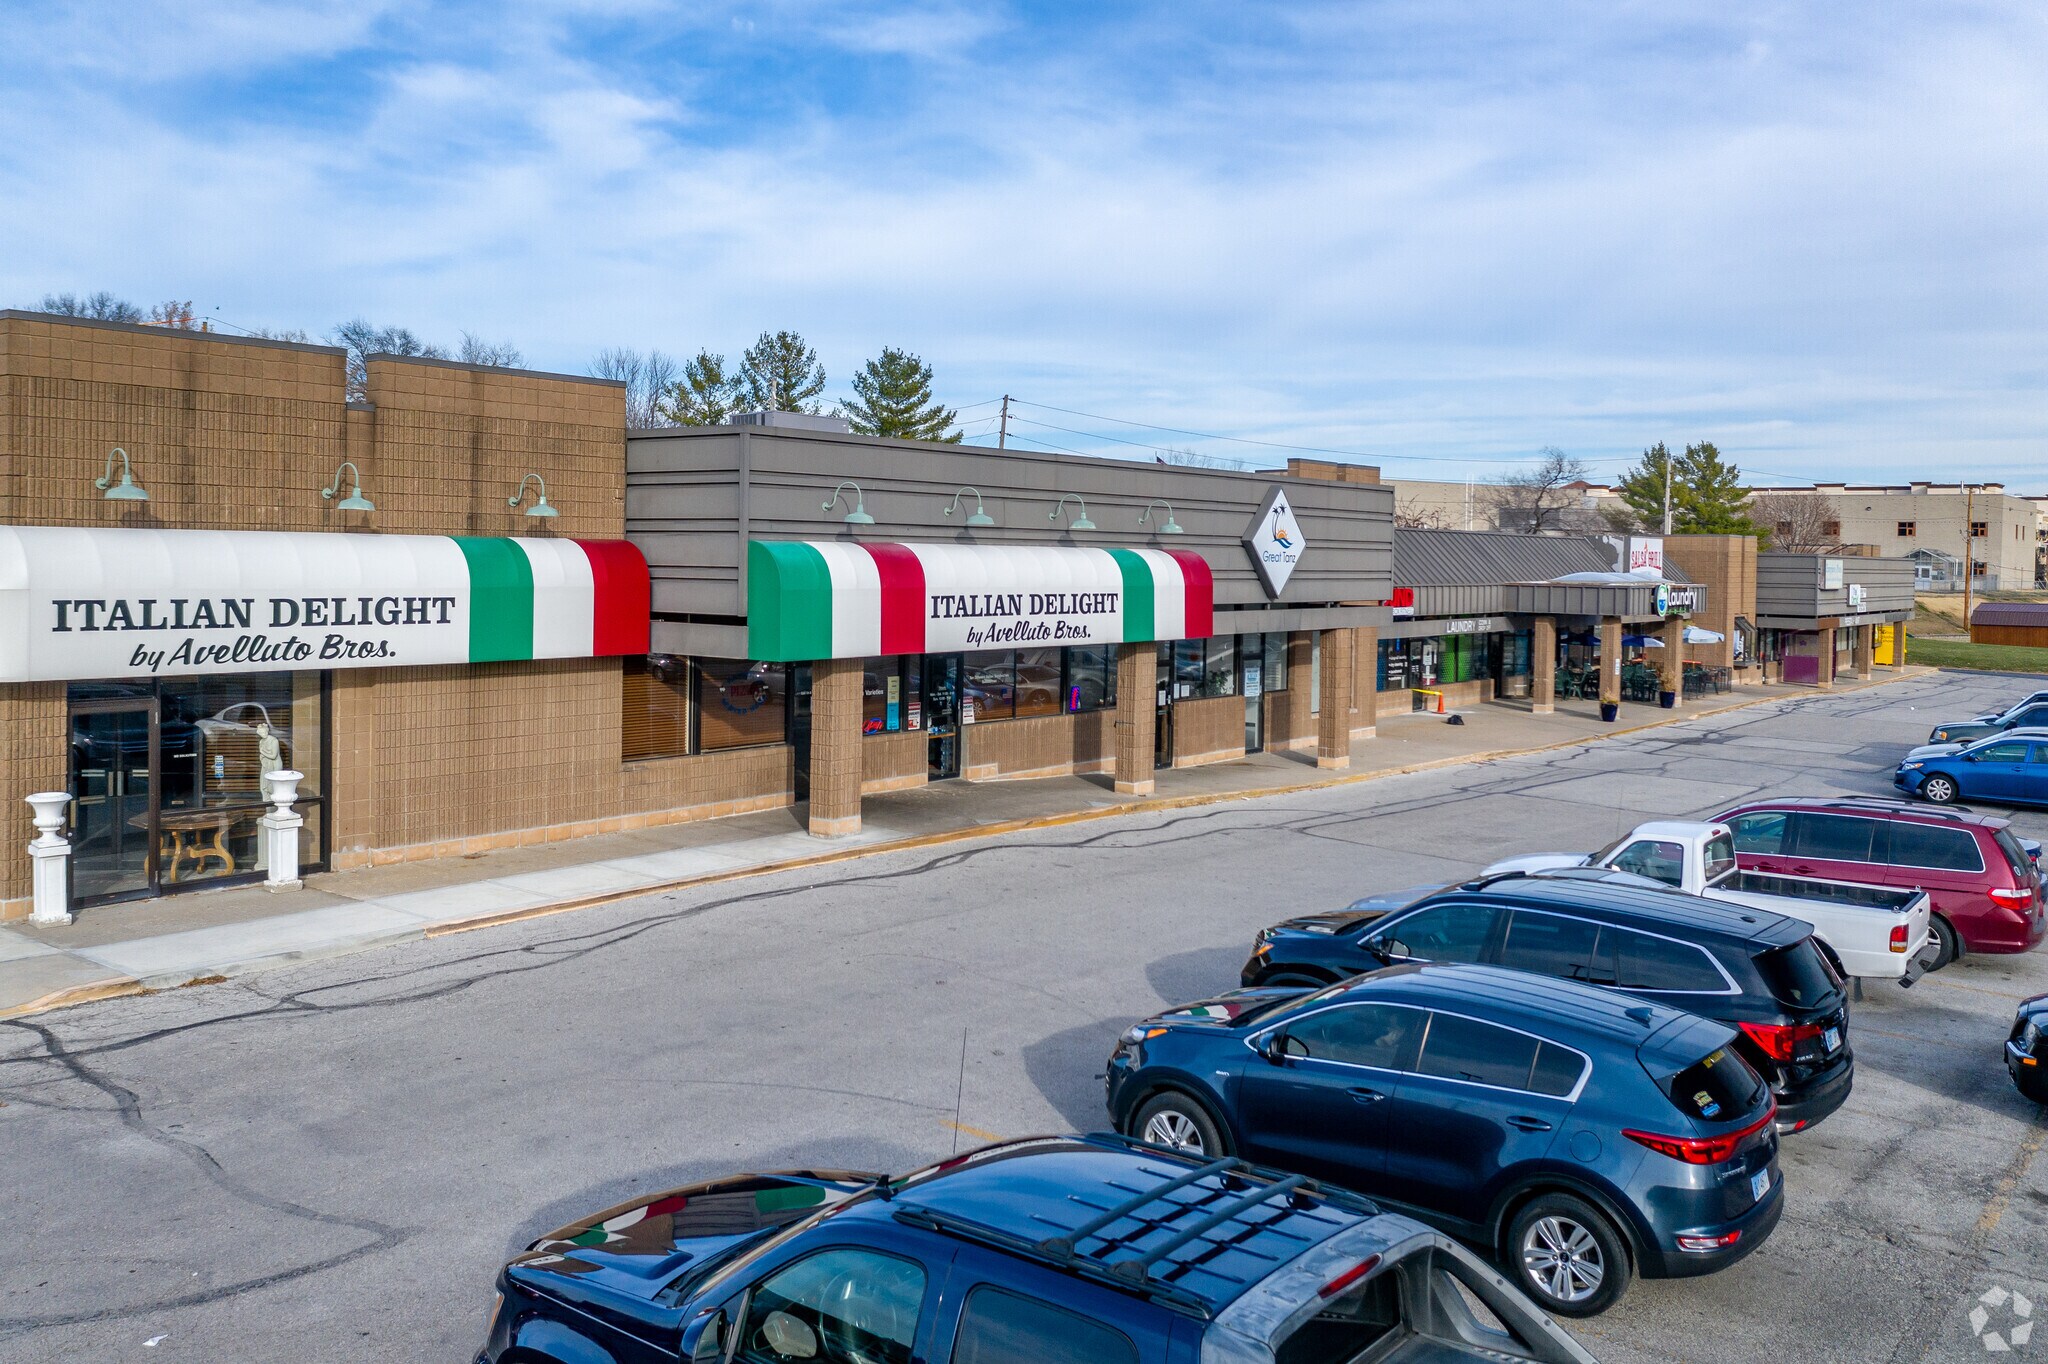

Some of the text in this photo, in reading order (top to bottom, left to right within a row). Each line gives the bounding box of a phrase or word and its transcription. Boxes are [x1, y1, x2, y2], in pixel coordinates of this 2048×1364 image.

[1263, 551, 1296, 563] Great Tanz
[52, 596, 455, 632] ITALIAN DELIGHT
[931, 593, 1119, 618] ITALIAN DELIGHT
[967, 620, 1091, 647] by Avelluto Bros.
[1446, 620, 1476, 633] LAUNDRY
[129, 633, 396, 672] by Avelluto Bros.
